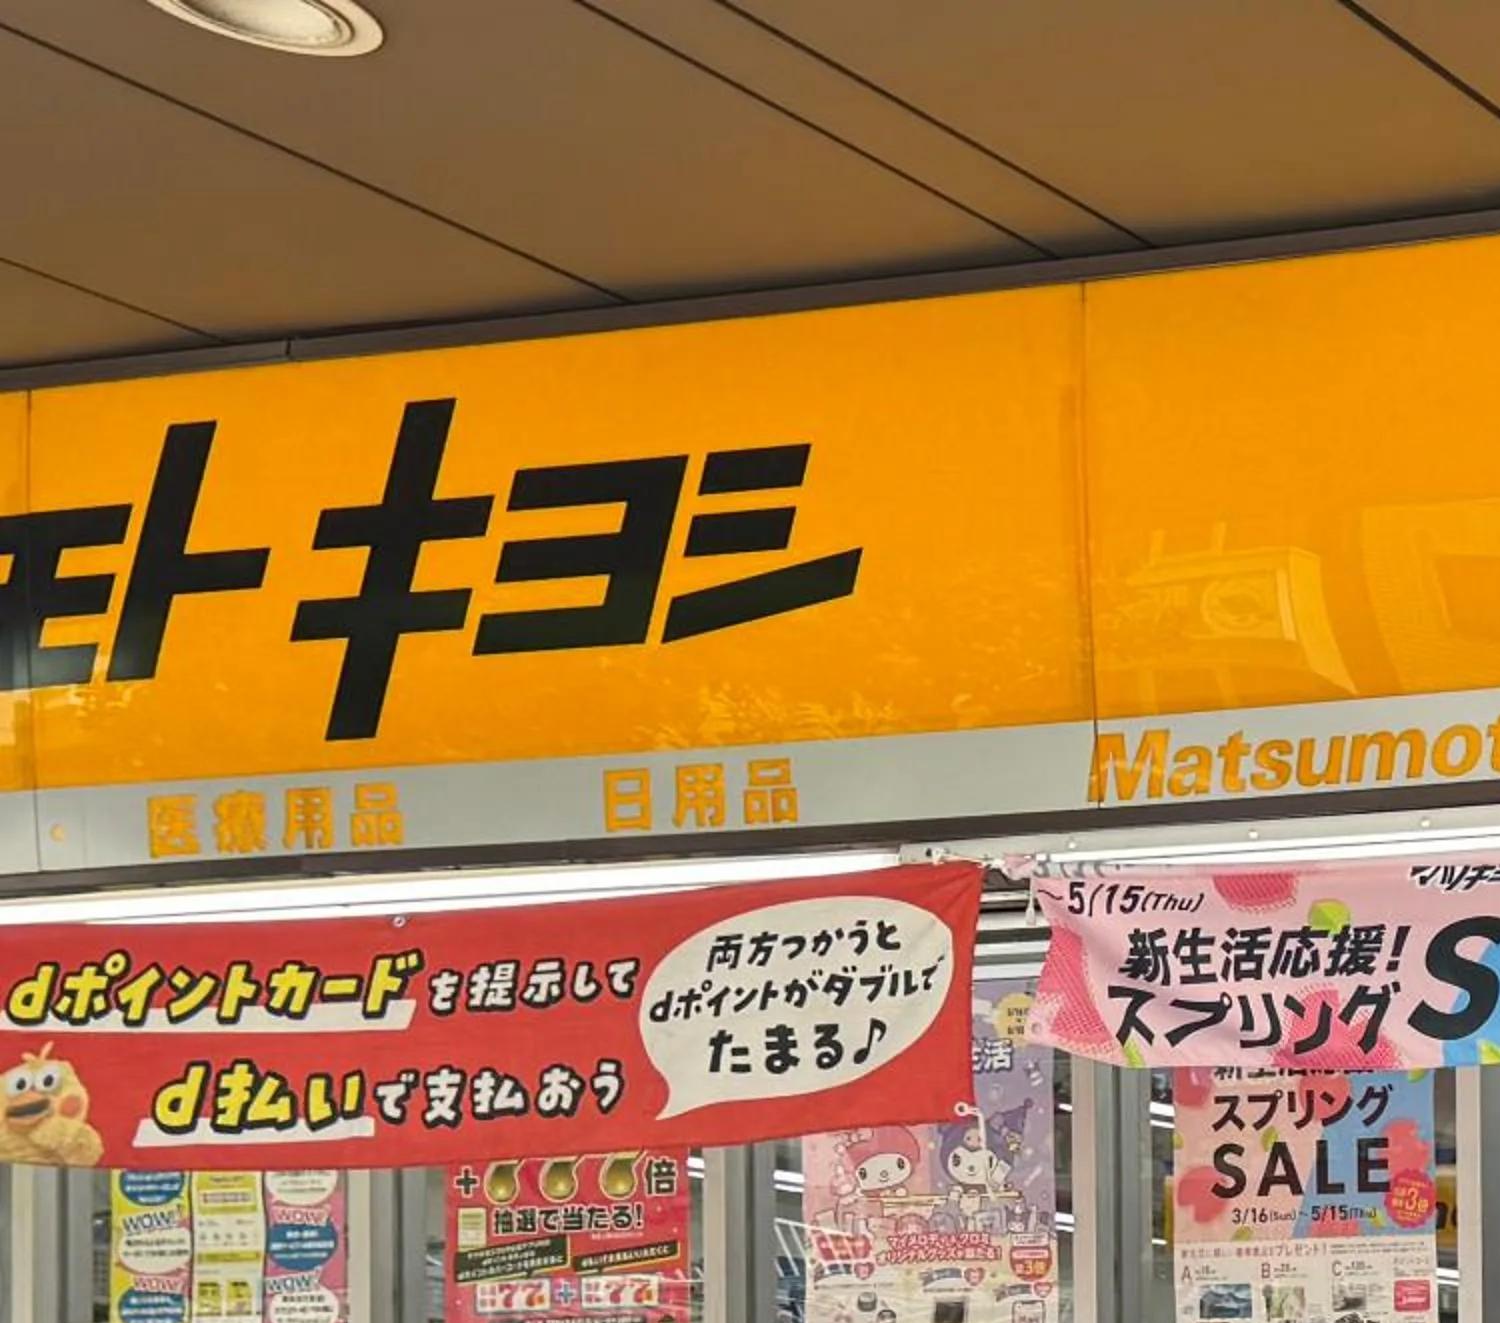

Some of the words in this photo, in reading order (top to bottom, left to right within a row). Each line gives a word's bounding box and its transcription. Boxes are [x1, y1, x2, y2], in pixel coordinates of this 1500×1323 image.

[146, 782, 406, 858] 医療用品
[603, 758, 801, 833] 日用品
[705, 920, 902, 972] 両方つかうと
[1118, 924, 1411, 987] 新生活応援!
[8, 948, 640, 1026] dポイントカードを提示して
[650, 955, 942, 1024] dポイントがダブルで
[1106, 983, 1402, 1055] スプリング
[154, 1058, 626, 1134] d払いで支払おう
[1211, 1084, 1394, 1132] スプリング
[1211, 1137, 1391, 1199] SALE
[494, 1205, 643, 1234] 抽選で当たる!
